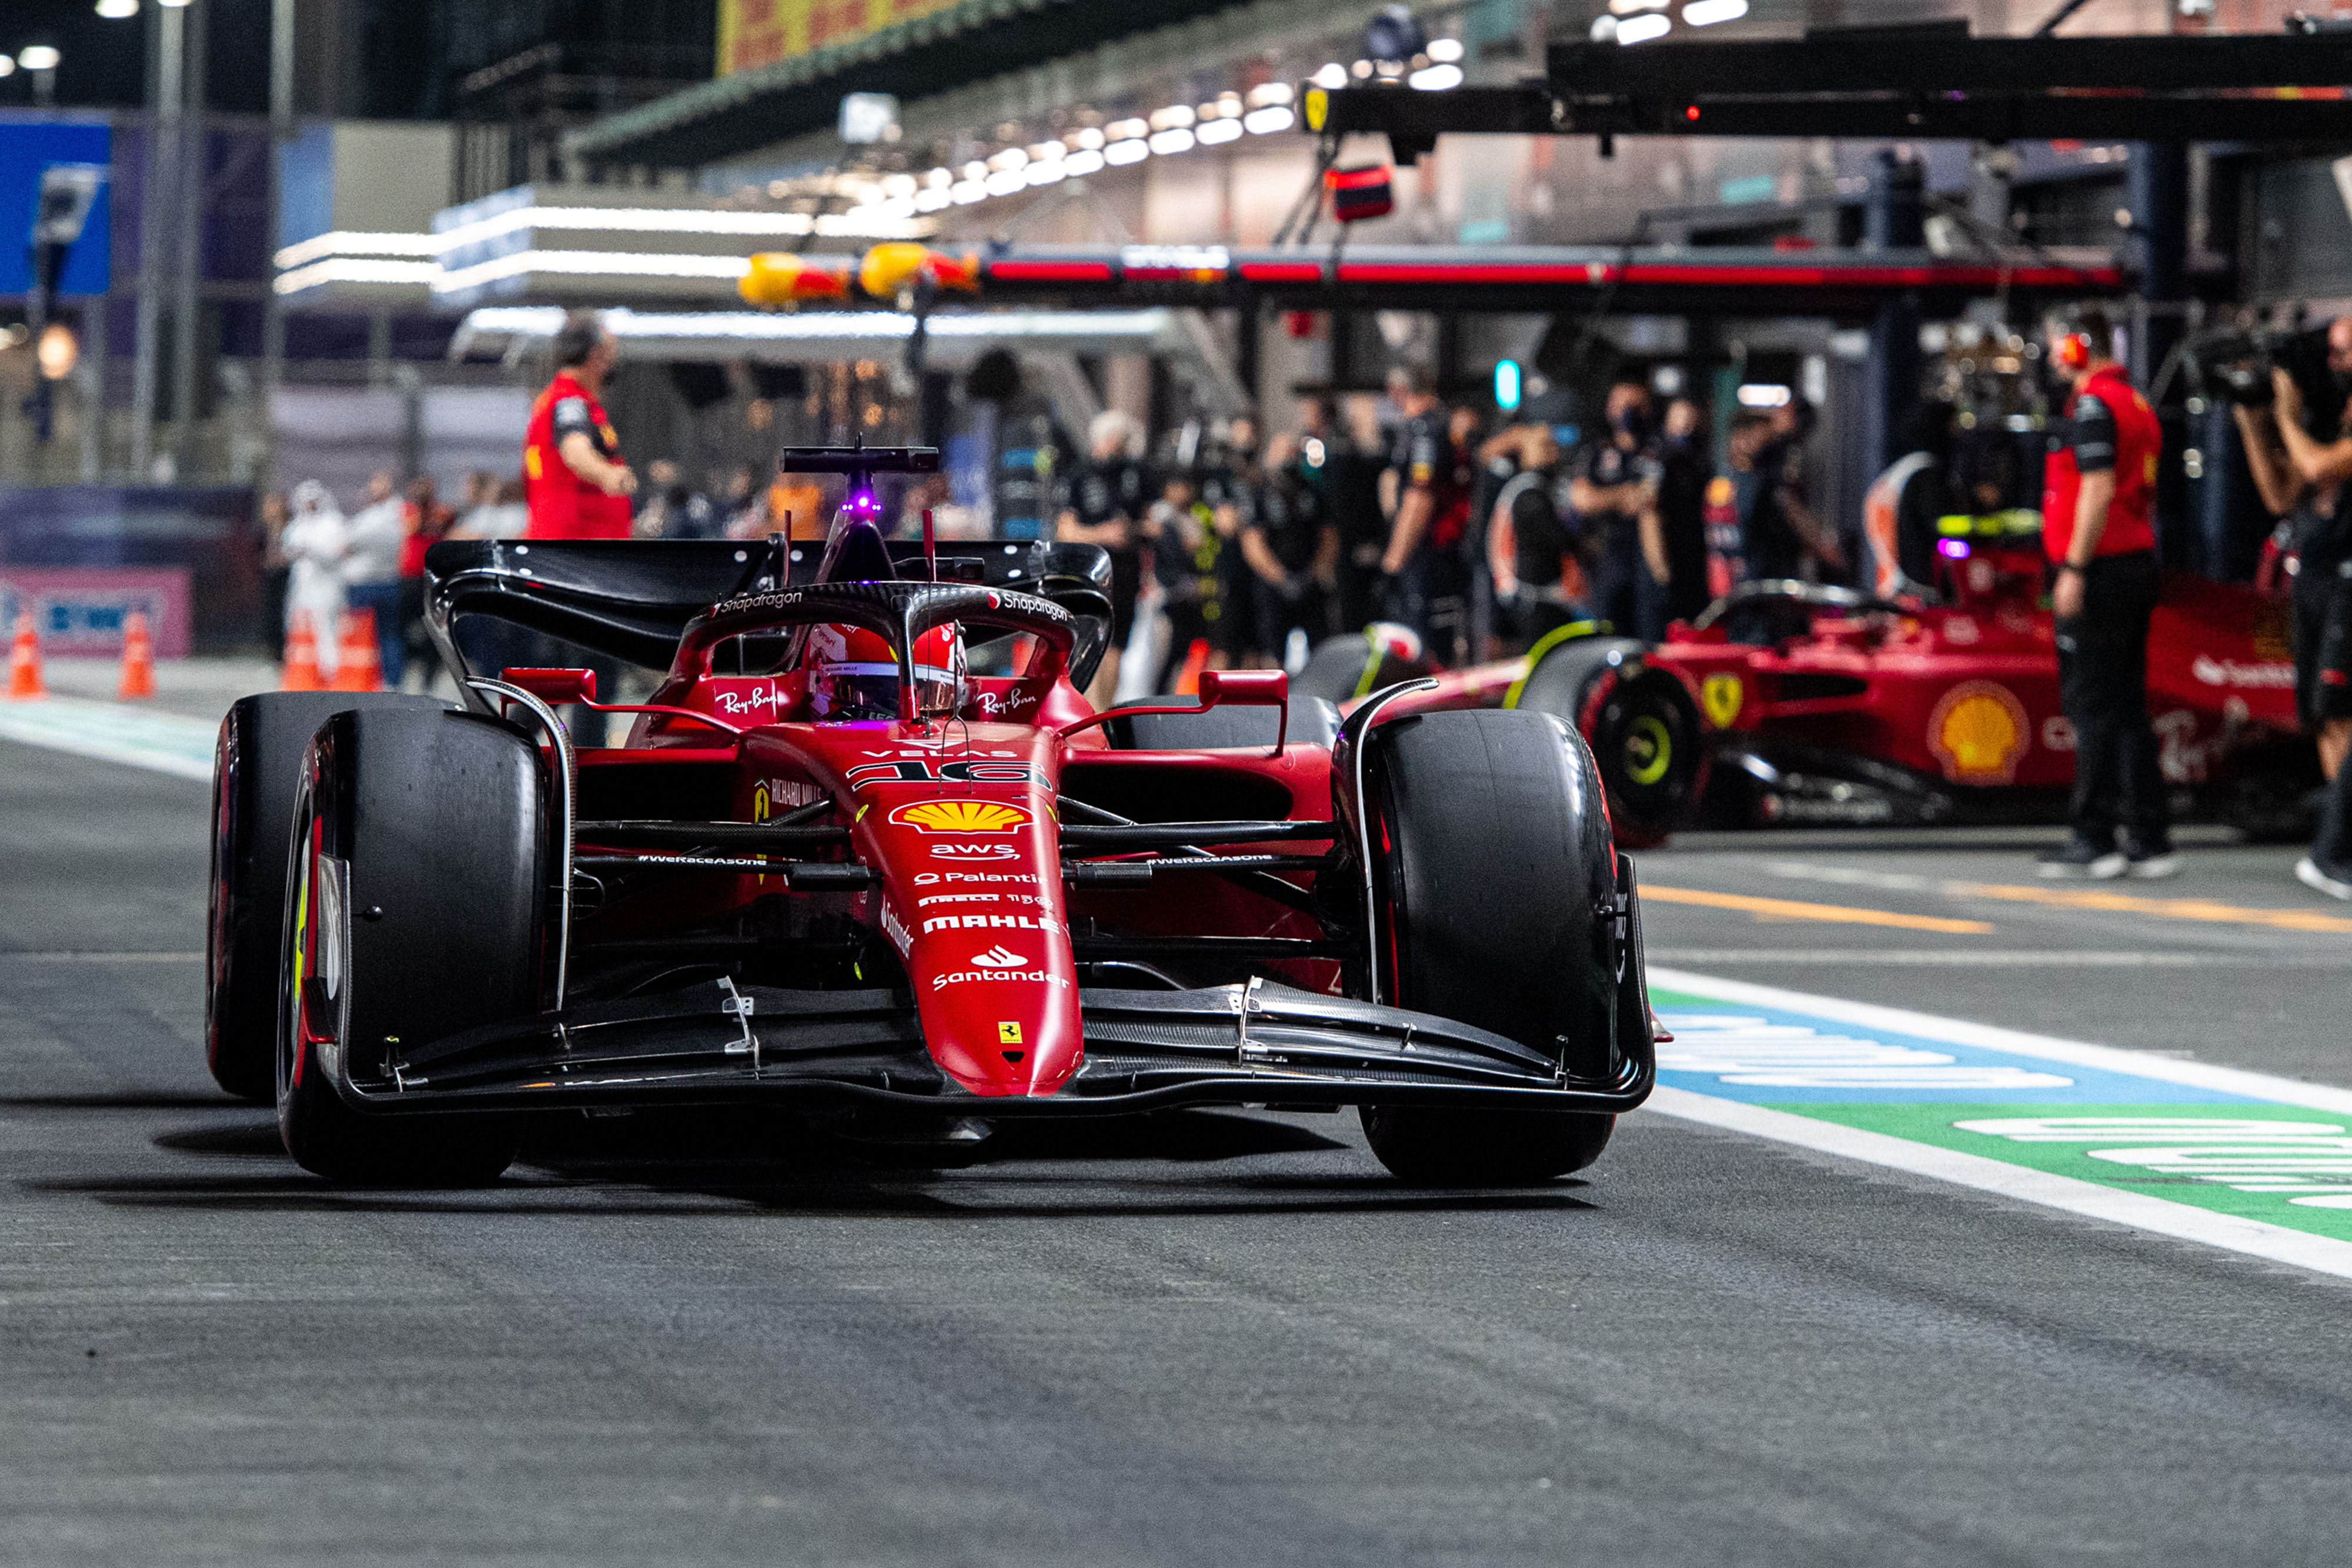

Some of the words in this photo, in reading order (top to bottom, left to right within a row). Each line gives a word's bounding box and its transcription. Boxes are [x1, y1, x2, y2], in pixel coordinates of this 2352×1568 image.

[721, 592, 802, 613] Snapdragon
[1004, 594, 1067, 621] Snapdragon
[715, 687, 777, 714] Ray-Ban
[976, 688, 1036, 714] Ray-Ban
[846, 760, 1053, 792] 16
[772, 778, 800, 807] RICHARD
[931, 844, 1015, 854] aws
[638, 855, 767, 865] #WeRaceAsOne
[1147, 855, 1272, 865] #WeRaceAsOne
[945, 872, 1048, 884] Palantir
[923, 915, 1060, 934] MAHLE
[933, 969, 1070, 991] Santander
